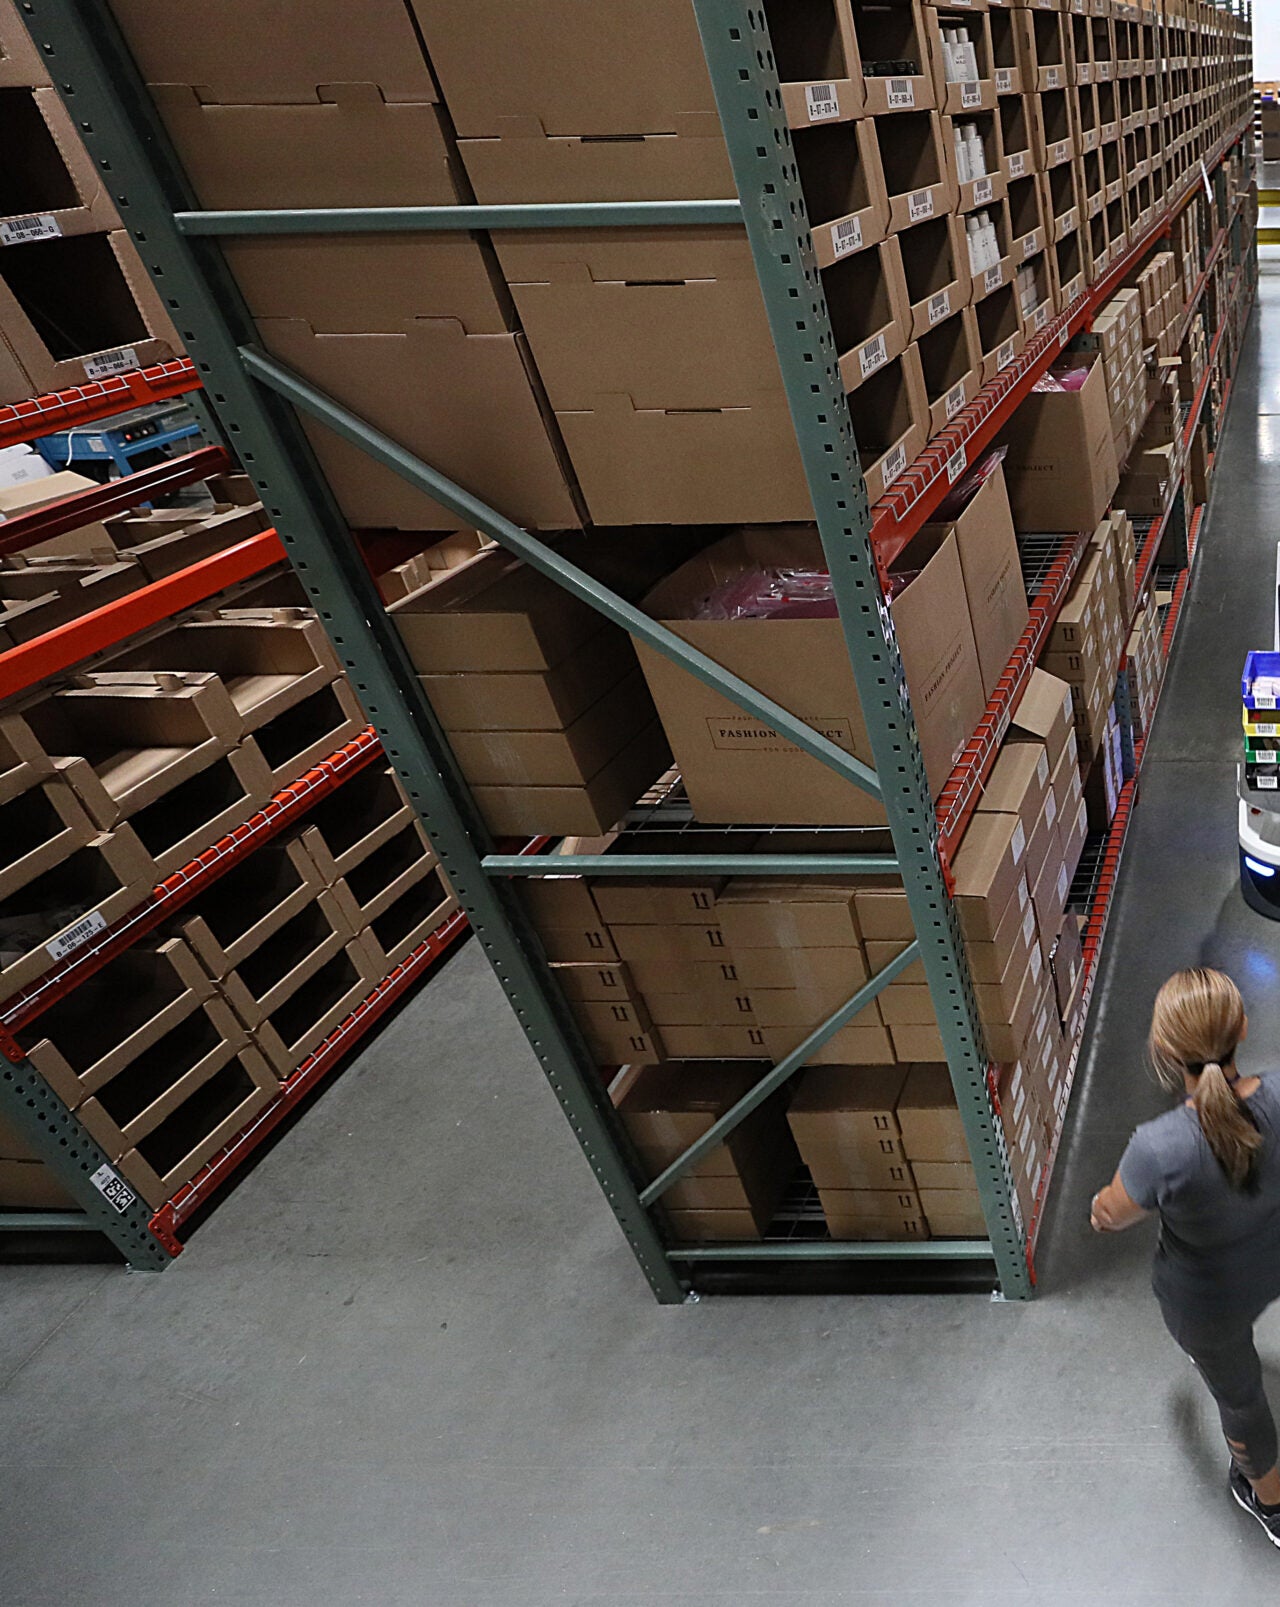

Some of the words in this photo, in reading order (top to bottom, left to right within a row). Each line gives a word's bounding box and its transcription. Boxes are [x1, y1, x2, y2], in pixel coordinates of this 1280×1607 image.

[924, 672, 946, 703] FASHION
[944, 643, 963, 674] PROJECT
[719, 729, 777, 738] FASHION
